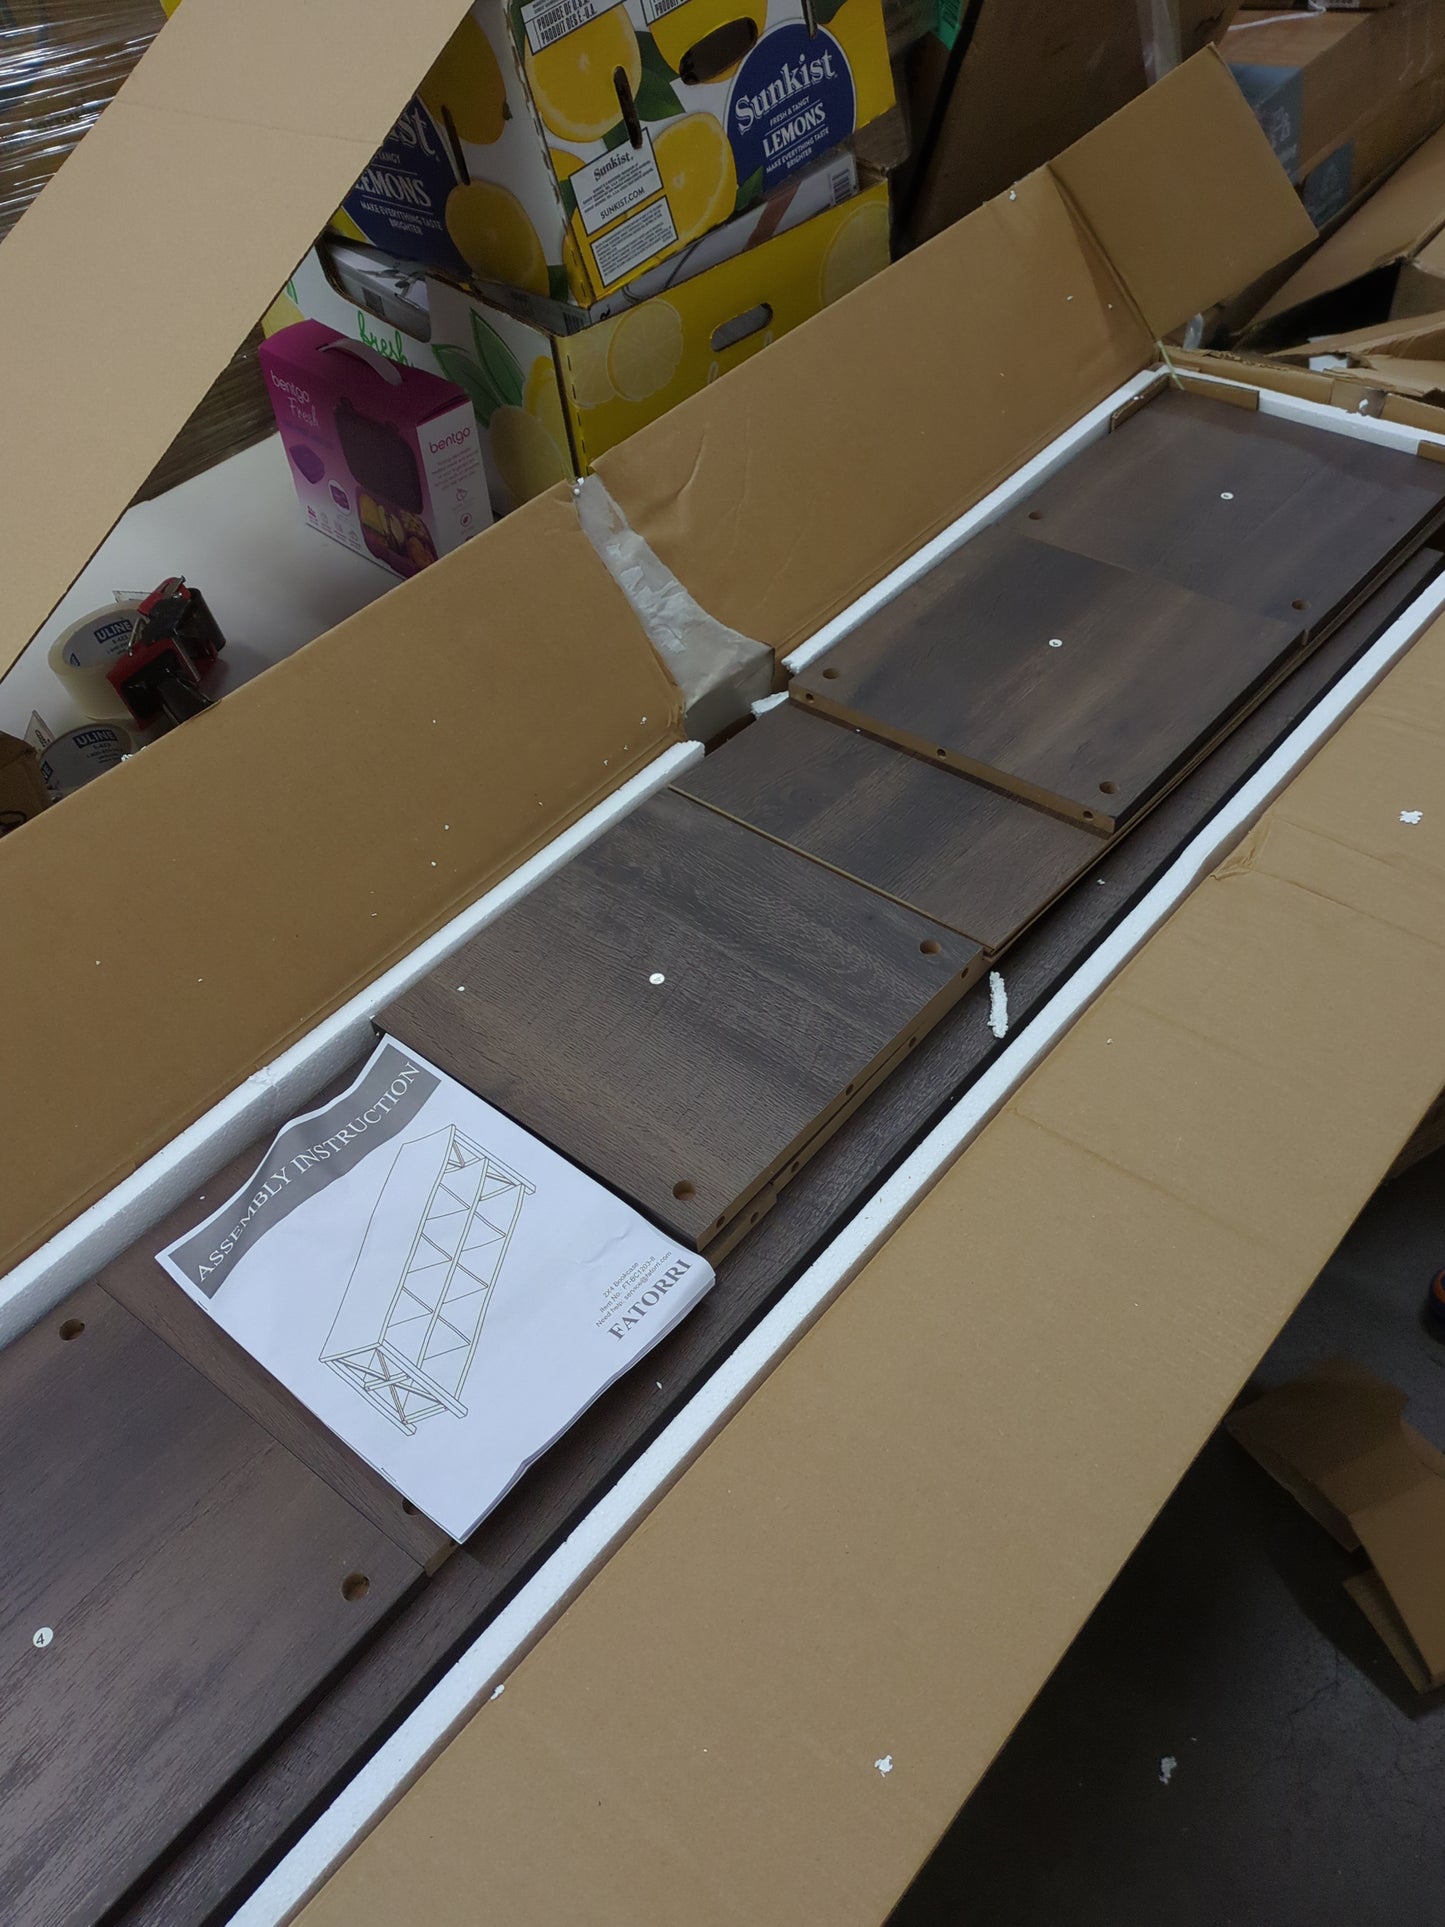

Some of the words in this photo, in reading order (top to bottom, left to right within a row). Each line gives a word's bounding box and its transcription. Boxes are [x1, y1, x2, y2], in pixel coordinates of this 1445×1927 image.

[537, 5, 564, 31] PRODUCE
[564, 1, 572, 16] OF
[541, 21, 566, 44] PRODUIT
[566, 13, 578, 30] DES
[735, 50, 836, 136] Sunkist
[769, 110, 788, 127] FRESH
[792, 96, 810, 113] TANGY
[762, 102, 826, 158] LEMONS
[766, 157, 781, 173] MAKE
[781, 137, 814, 164] EVERYTHING
[812, 127, 830, 143] TASTE
[787, 147, 812, 168] BRIGHTER
[600, 187, 645, 219] SUNKIST.COM
[270, 370, 310, 404] bentgo
[429, 427, 471, 454] bentgo
[98, 620, 133, 641] ULINE
[77, 730, 117, 747] ULINE
[198, 1168, 293, 1281] ASSEMBLY
[290, 1061, 421, 1175] INSTRUCTION
[613, 1262, 639, 1288] Bookcase
[600, 1301, 613, 1313] Item
[607, 1259, 693, 1340] FATORRI
[596, 1312, 612, 1328] Need
